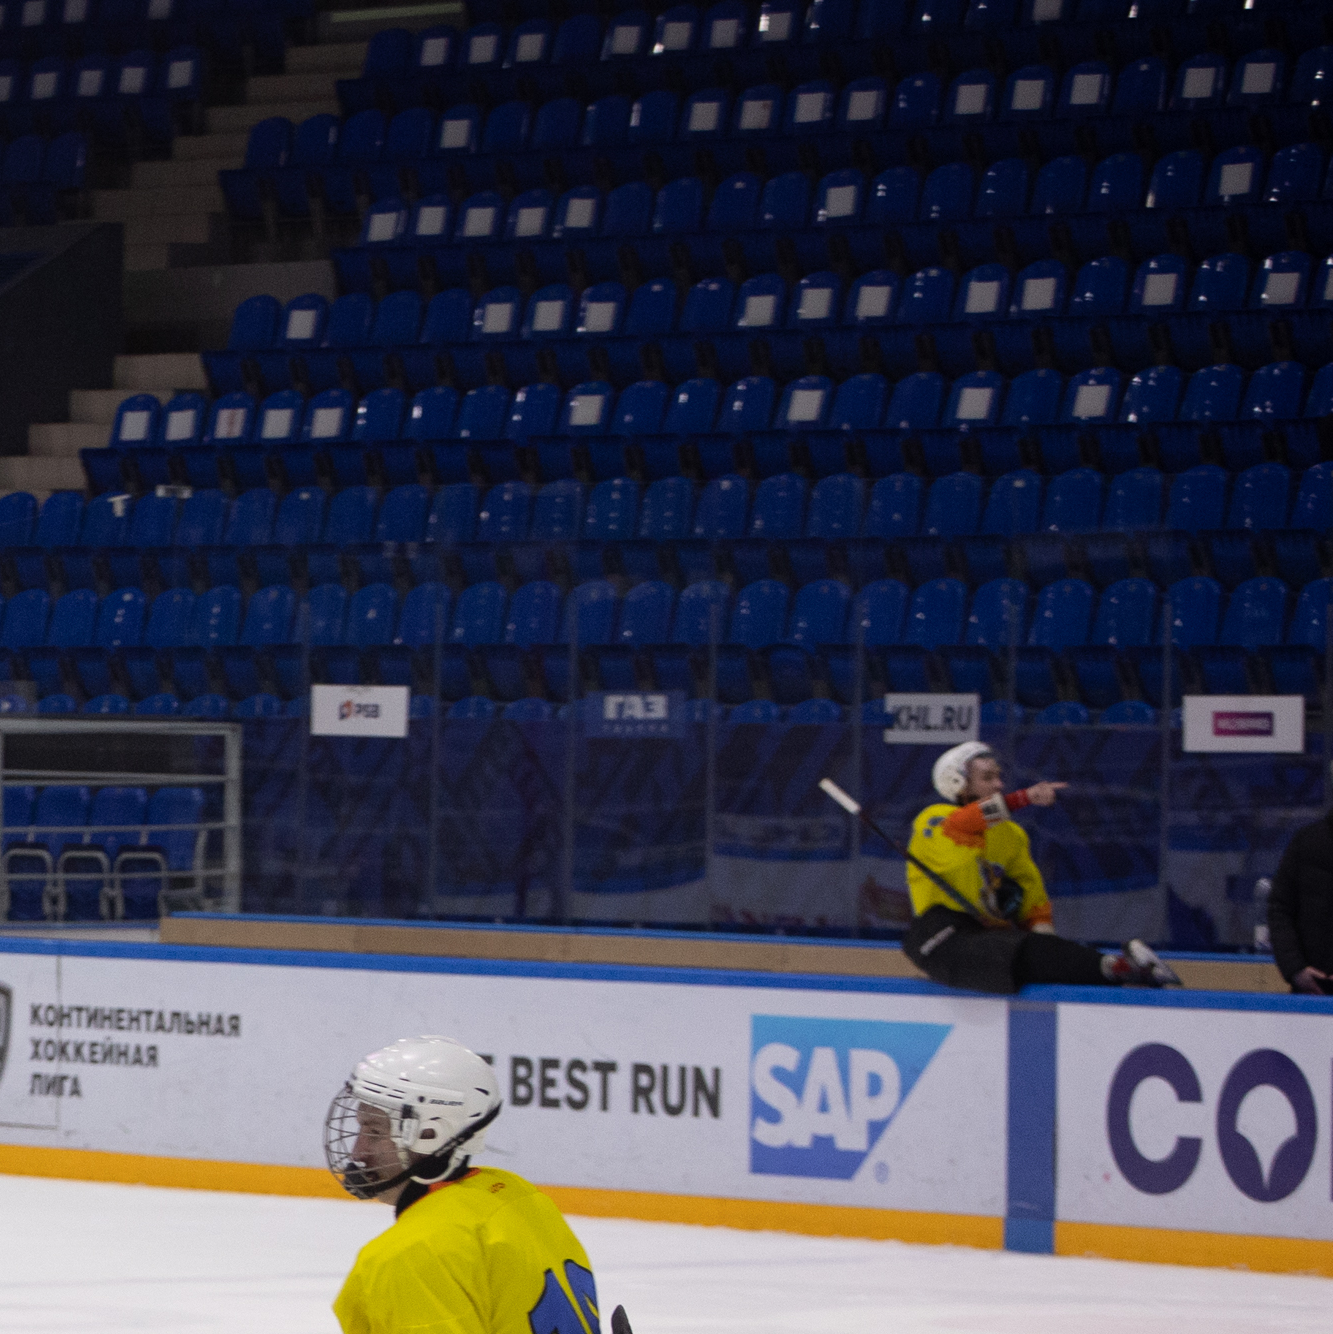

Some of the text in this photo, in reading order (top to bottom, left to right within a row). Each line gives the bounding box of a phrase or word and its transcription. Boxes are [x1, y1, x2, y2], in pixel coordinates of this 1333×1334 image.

[603, 694, 668, 720] ГАЗ
[29, 1003, 242, 1038] КОНТИНЕНТАЛЬНАЯ
[29, 1037, 159, 1067] ХОККЕЙНАЯ
[29, 1073, 83, 1098] ЛИГА
[510, 1054, 724, 1120] BEST RUN
[752, 1042, 904, 1152] SAP
